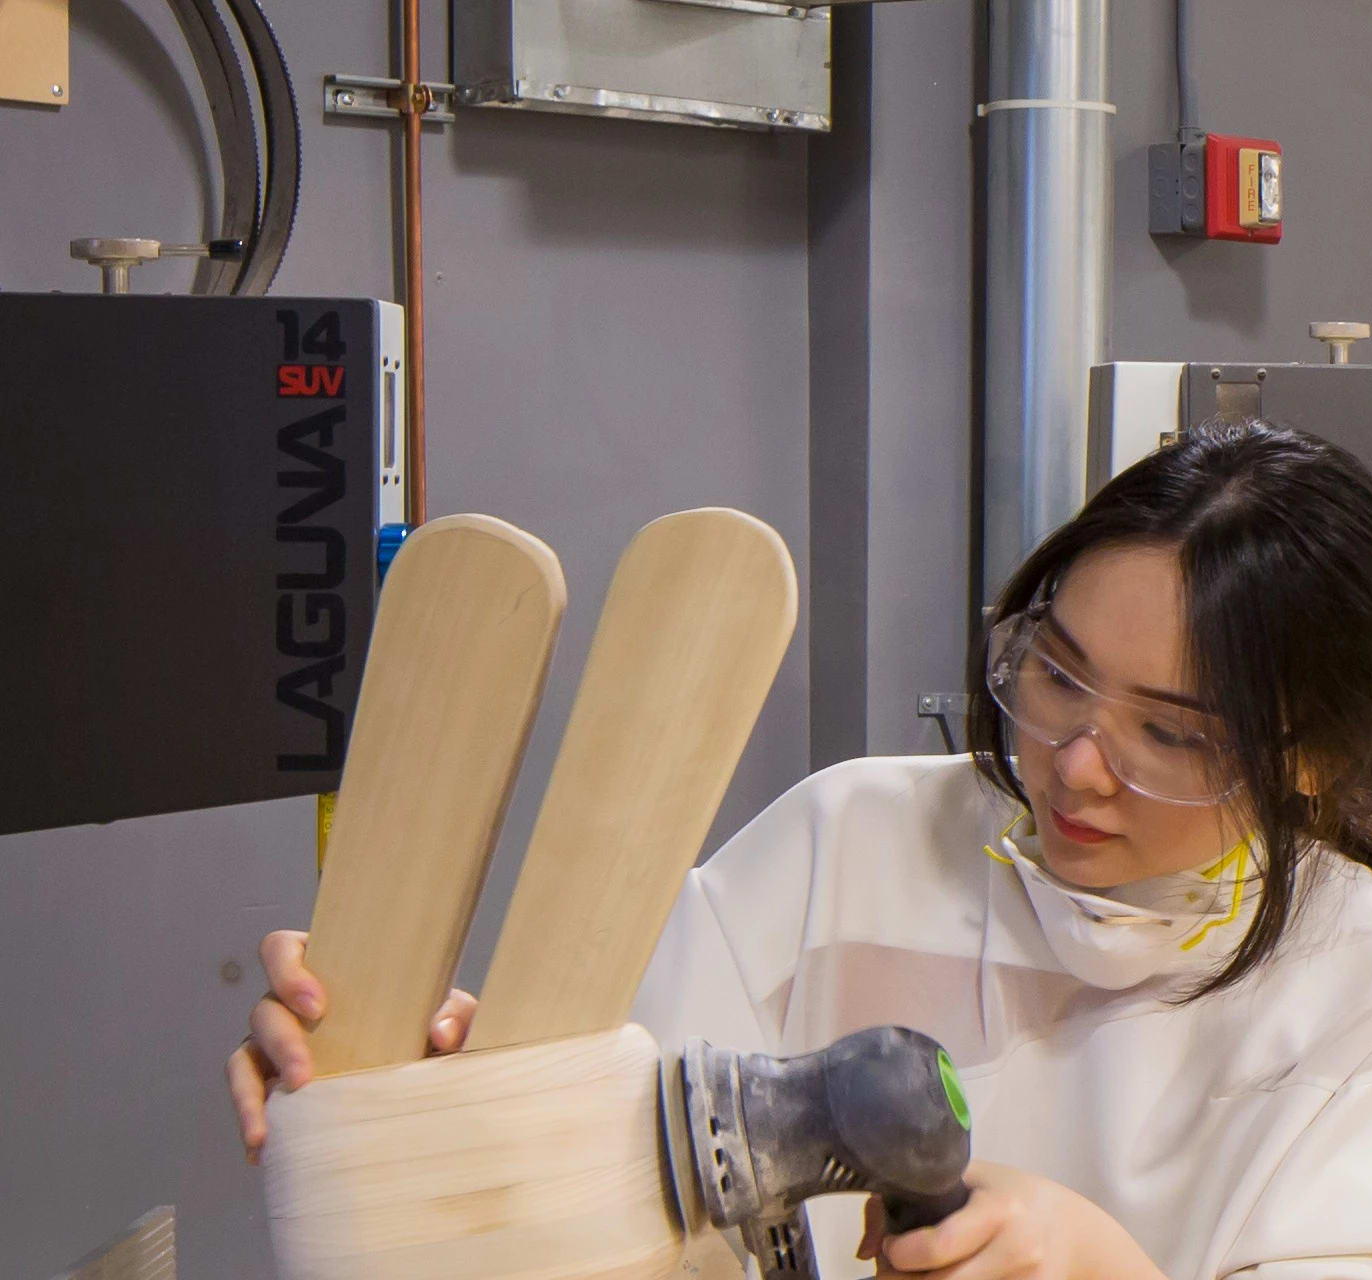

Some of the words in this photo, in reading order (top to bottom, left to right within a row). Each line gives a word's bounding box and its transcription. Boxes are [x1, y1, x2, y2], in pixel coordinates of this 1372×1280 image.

[276, 309, 346, 361] 14
[278, 365, 345, 397] SUV
[276, 405, 346, 772] LAGUNA
